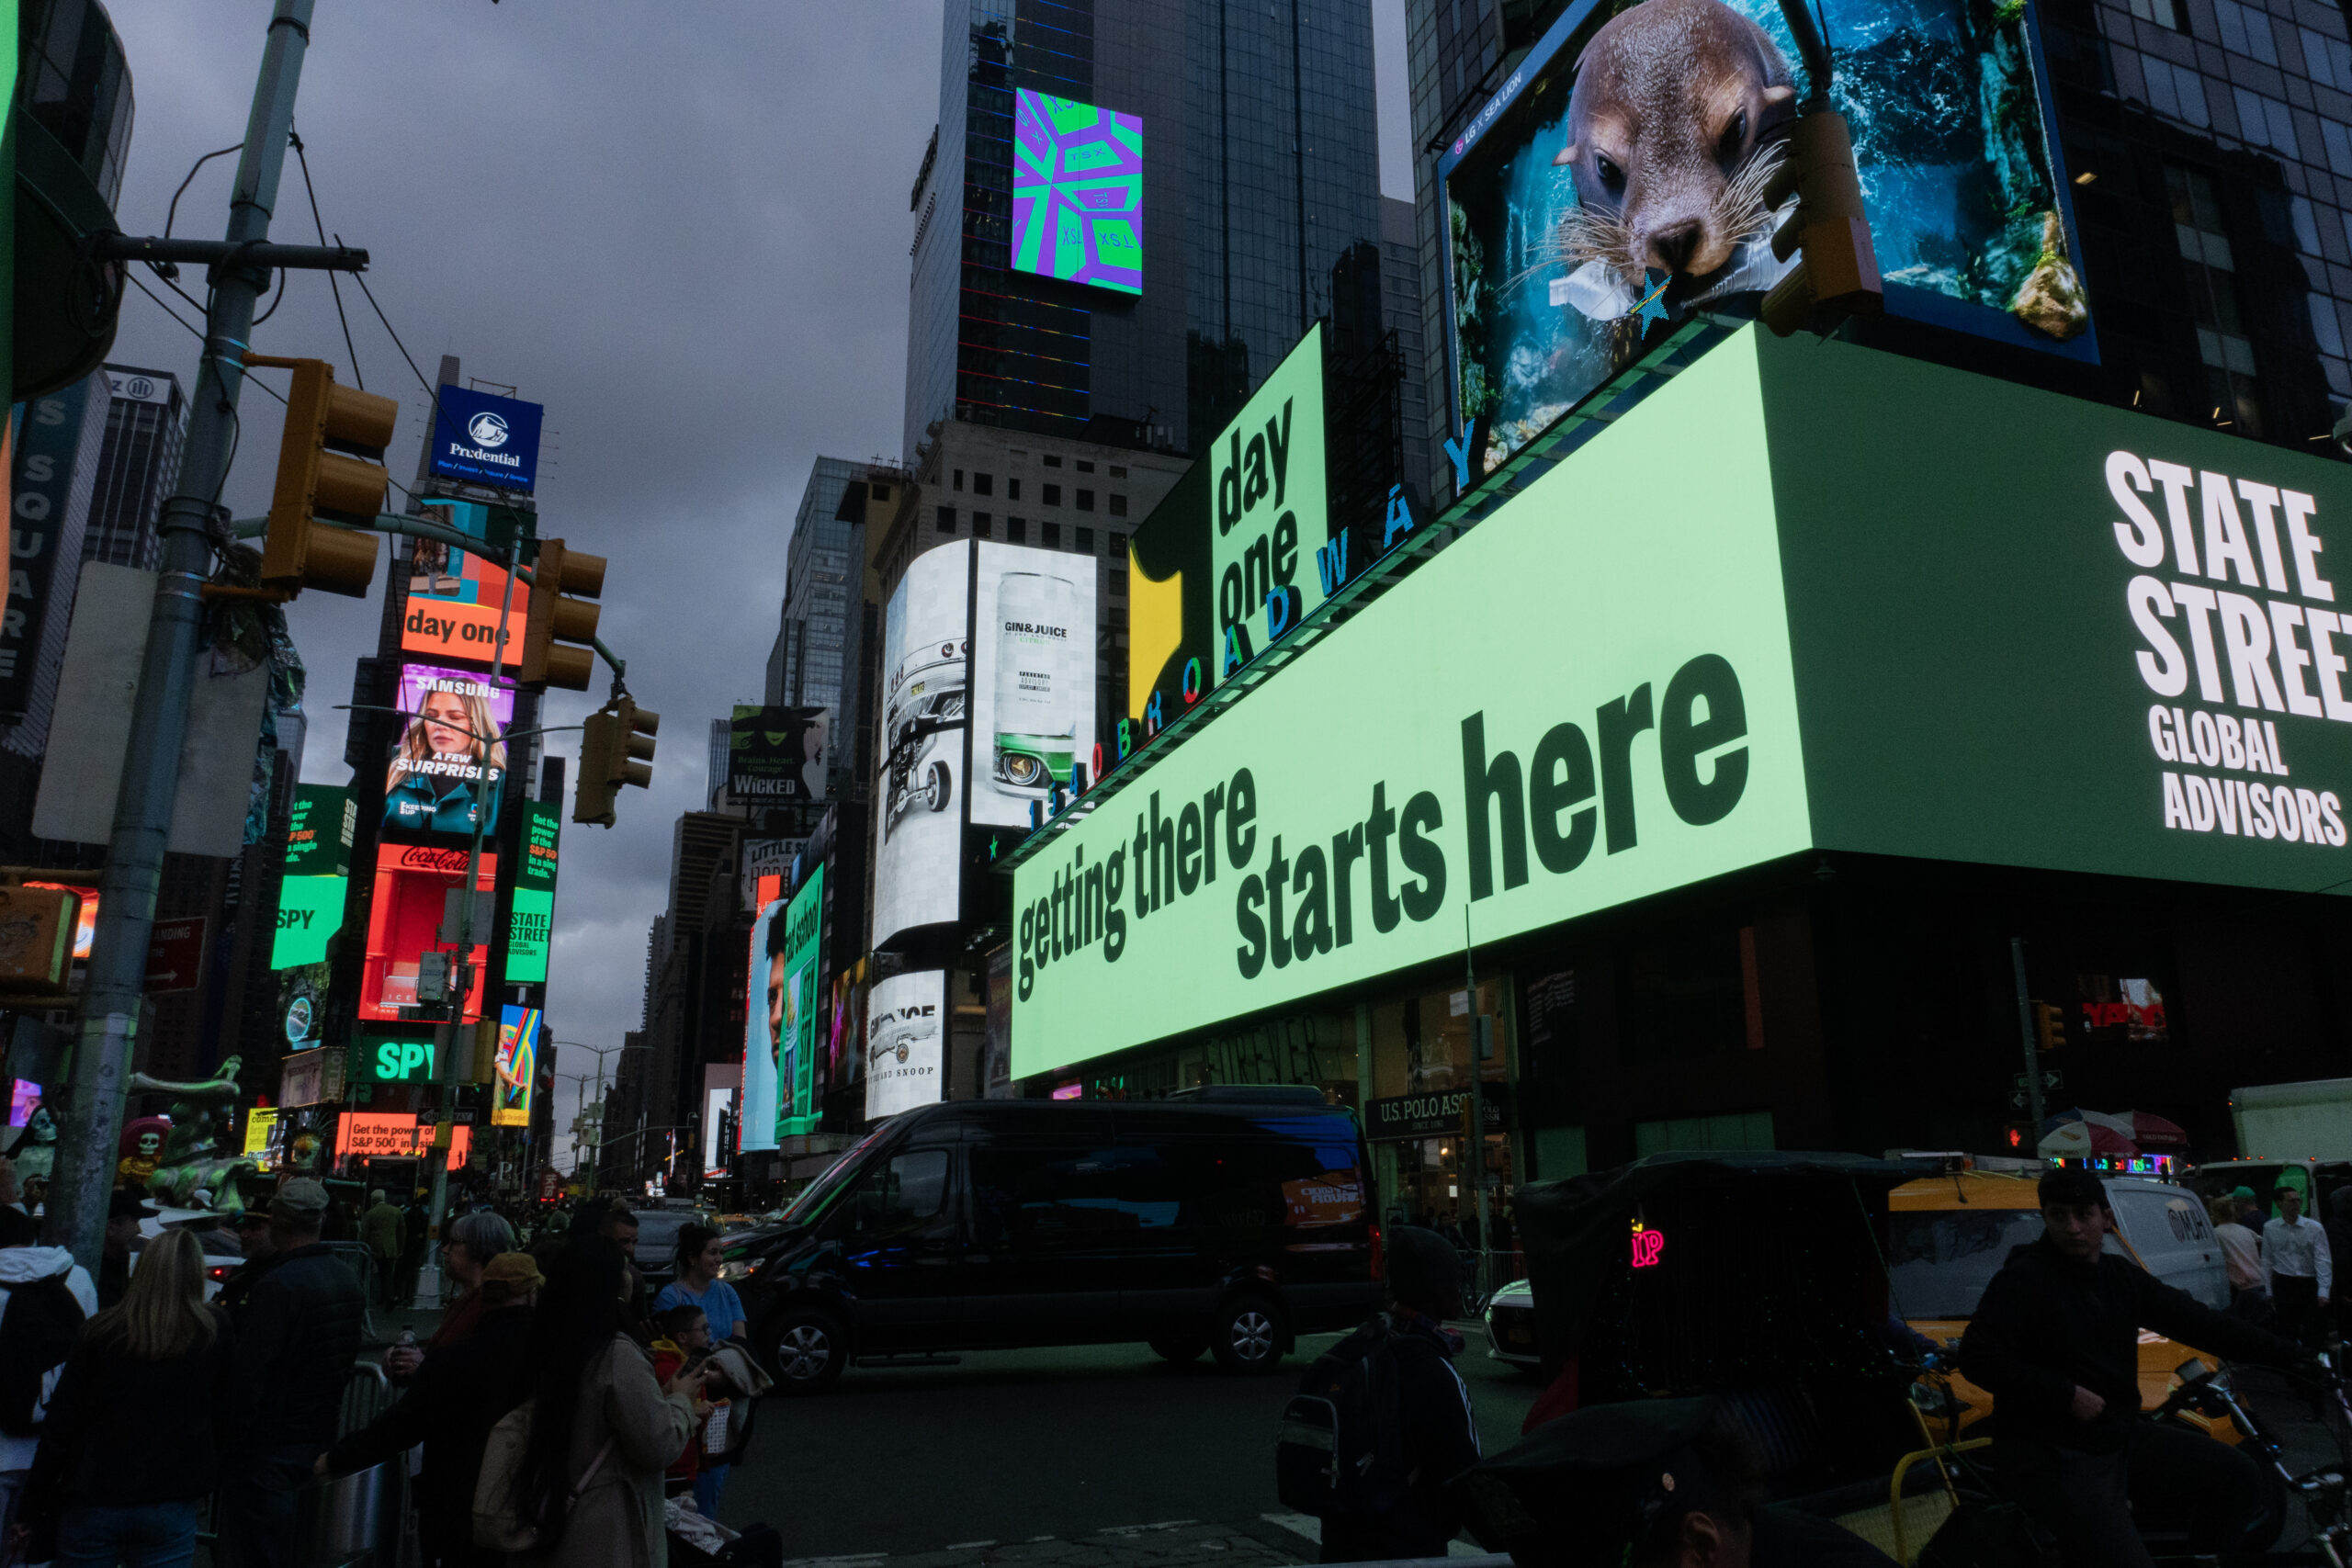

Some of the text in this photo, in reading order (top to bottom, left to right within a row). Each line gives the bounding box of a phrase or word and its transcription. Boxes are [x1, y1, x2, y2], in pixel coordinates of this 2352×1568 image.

[1464, 125, 1476, 145] LG
[1485, 97, 1501, 122] SEA
[1501, 72, 1522, 102] LION
[1070, 147, 1106, 161] TSX
[449, 442, 521, 468] Prudential
[1218, 395, 1294, 537] day
[483, 468, 504, 479] nsure
[2105, 449, 2335, 602] STATE
[1219, 509, 1298, 634] one
[406, 608, 511, 647] day one
[415, 676, 501, 699] SAMSUNG
[2148, 704, 2290, 777] GLOBAL
[432, 751, 472, 763] A FEW
[1236, 652, 1749, 980] starts here
[2162, 771, 2348, 848] ADVISORS
[752, 840, 793, 863] LITTLE
[1017, 766, 1258, 1003] getting there
[276, 908, 315, 930] SPY
[511, 910, 548, 929] STATE
[896, 1066, 934, 1077] SNOOP
[1380, 1102, 1402, 1122] U.S.
[1403, 1097, 1440, 1120] POLO
[351, 1137, 373, 1147] S&P
[353, 1123, 370, 1134] Get
[373, 1123, 389, 1134] the
[394, 1126, 423, 1137] powr
